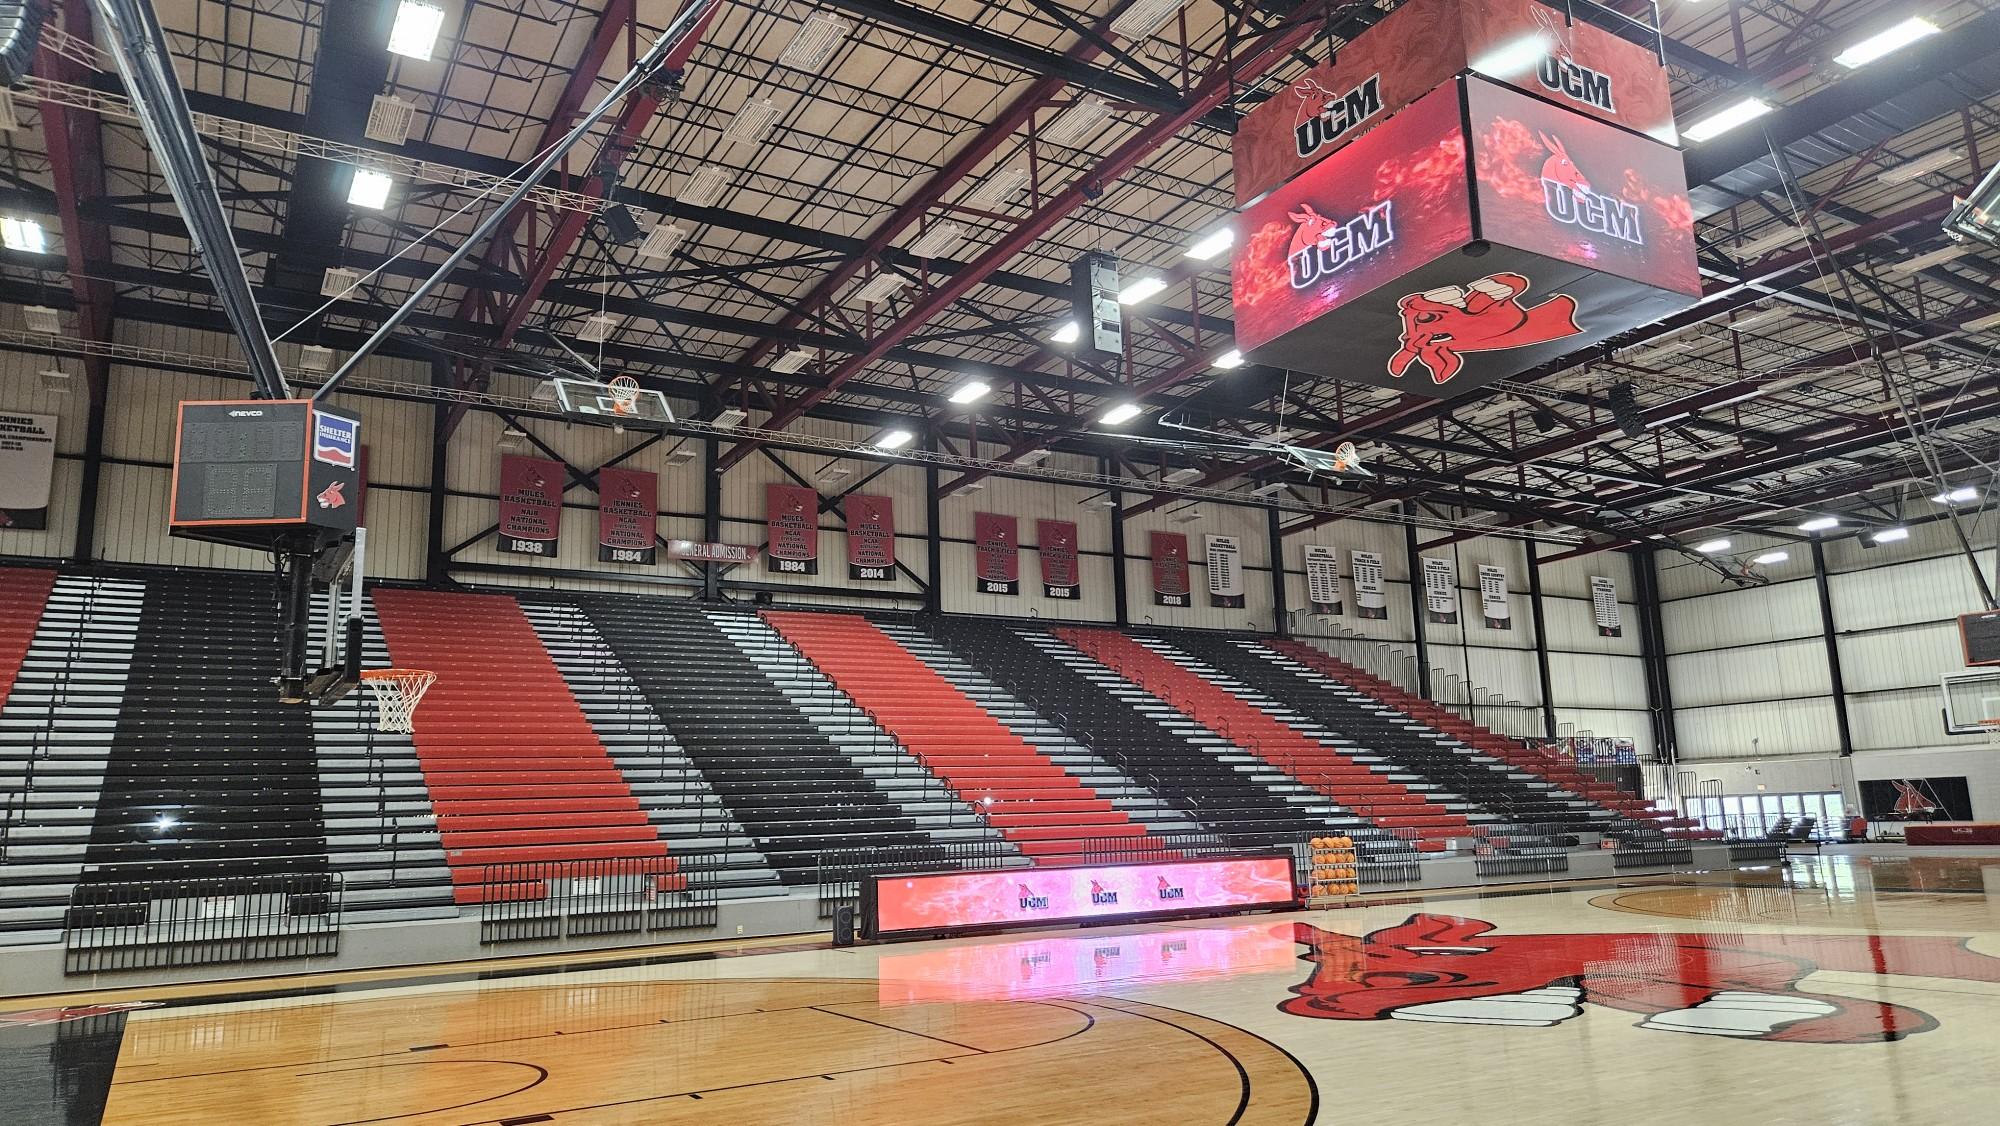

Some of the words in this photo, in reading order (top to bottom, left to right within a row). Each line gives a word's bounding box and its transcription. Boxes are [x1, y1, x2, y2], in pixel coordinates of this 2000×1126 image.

[1536, 50, 1616, 114] UCM
[1294, 73, 1384, 158] UCM
[1541, 178, 1643, 245] UCM
[1288, 199, 1394, 289] UCM
[319, 424, 352, 440] SHELTER
[319, 432, 351, 444] INSURANCE
[517, 488, 545, 499] MULES
[504, 495, 557, 508] BASKETBALL
[613, 500, 643, 509] JENNIES
[603, 507, 652, 518] BASKETBALL
[781, 514, 804, 522] MULES
[510, 516, 547, 526] NATIONAL
[771, 521, 814, 531] BASKETBALL
[506, 524, 550, 535] CHAMPIONS
[610, 529, 645, 539] NATIONAL
[850, 530, 890, 539] BASKETBALL
[511, 540, 543, 554] 1938
[607, 538, 647, 547] CHAMPIONS
[777, 541, 808, 550] NATIONAL
[612, 550, 642, 562] 1984
[681, 543, 710, 558] GENERAL
[711, 545, 746, 560] ADMISSION
[776, 549, 810, 558] CHAMPIONS
[780, 560, 806, 572] 1984
[860, 568, 885, 578] 2014
[986, 582, 1009, 593] 2015
[1049, 587, 1070, 598] 2015
[1162, 595, 1182, 605] 2018
[1091, 891, 1118, 904] UCM
[1159, 887, 1184, 899] UCM
[1019, 896, 1049, 909] UCM
